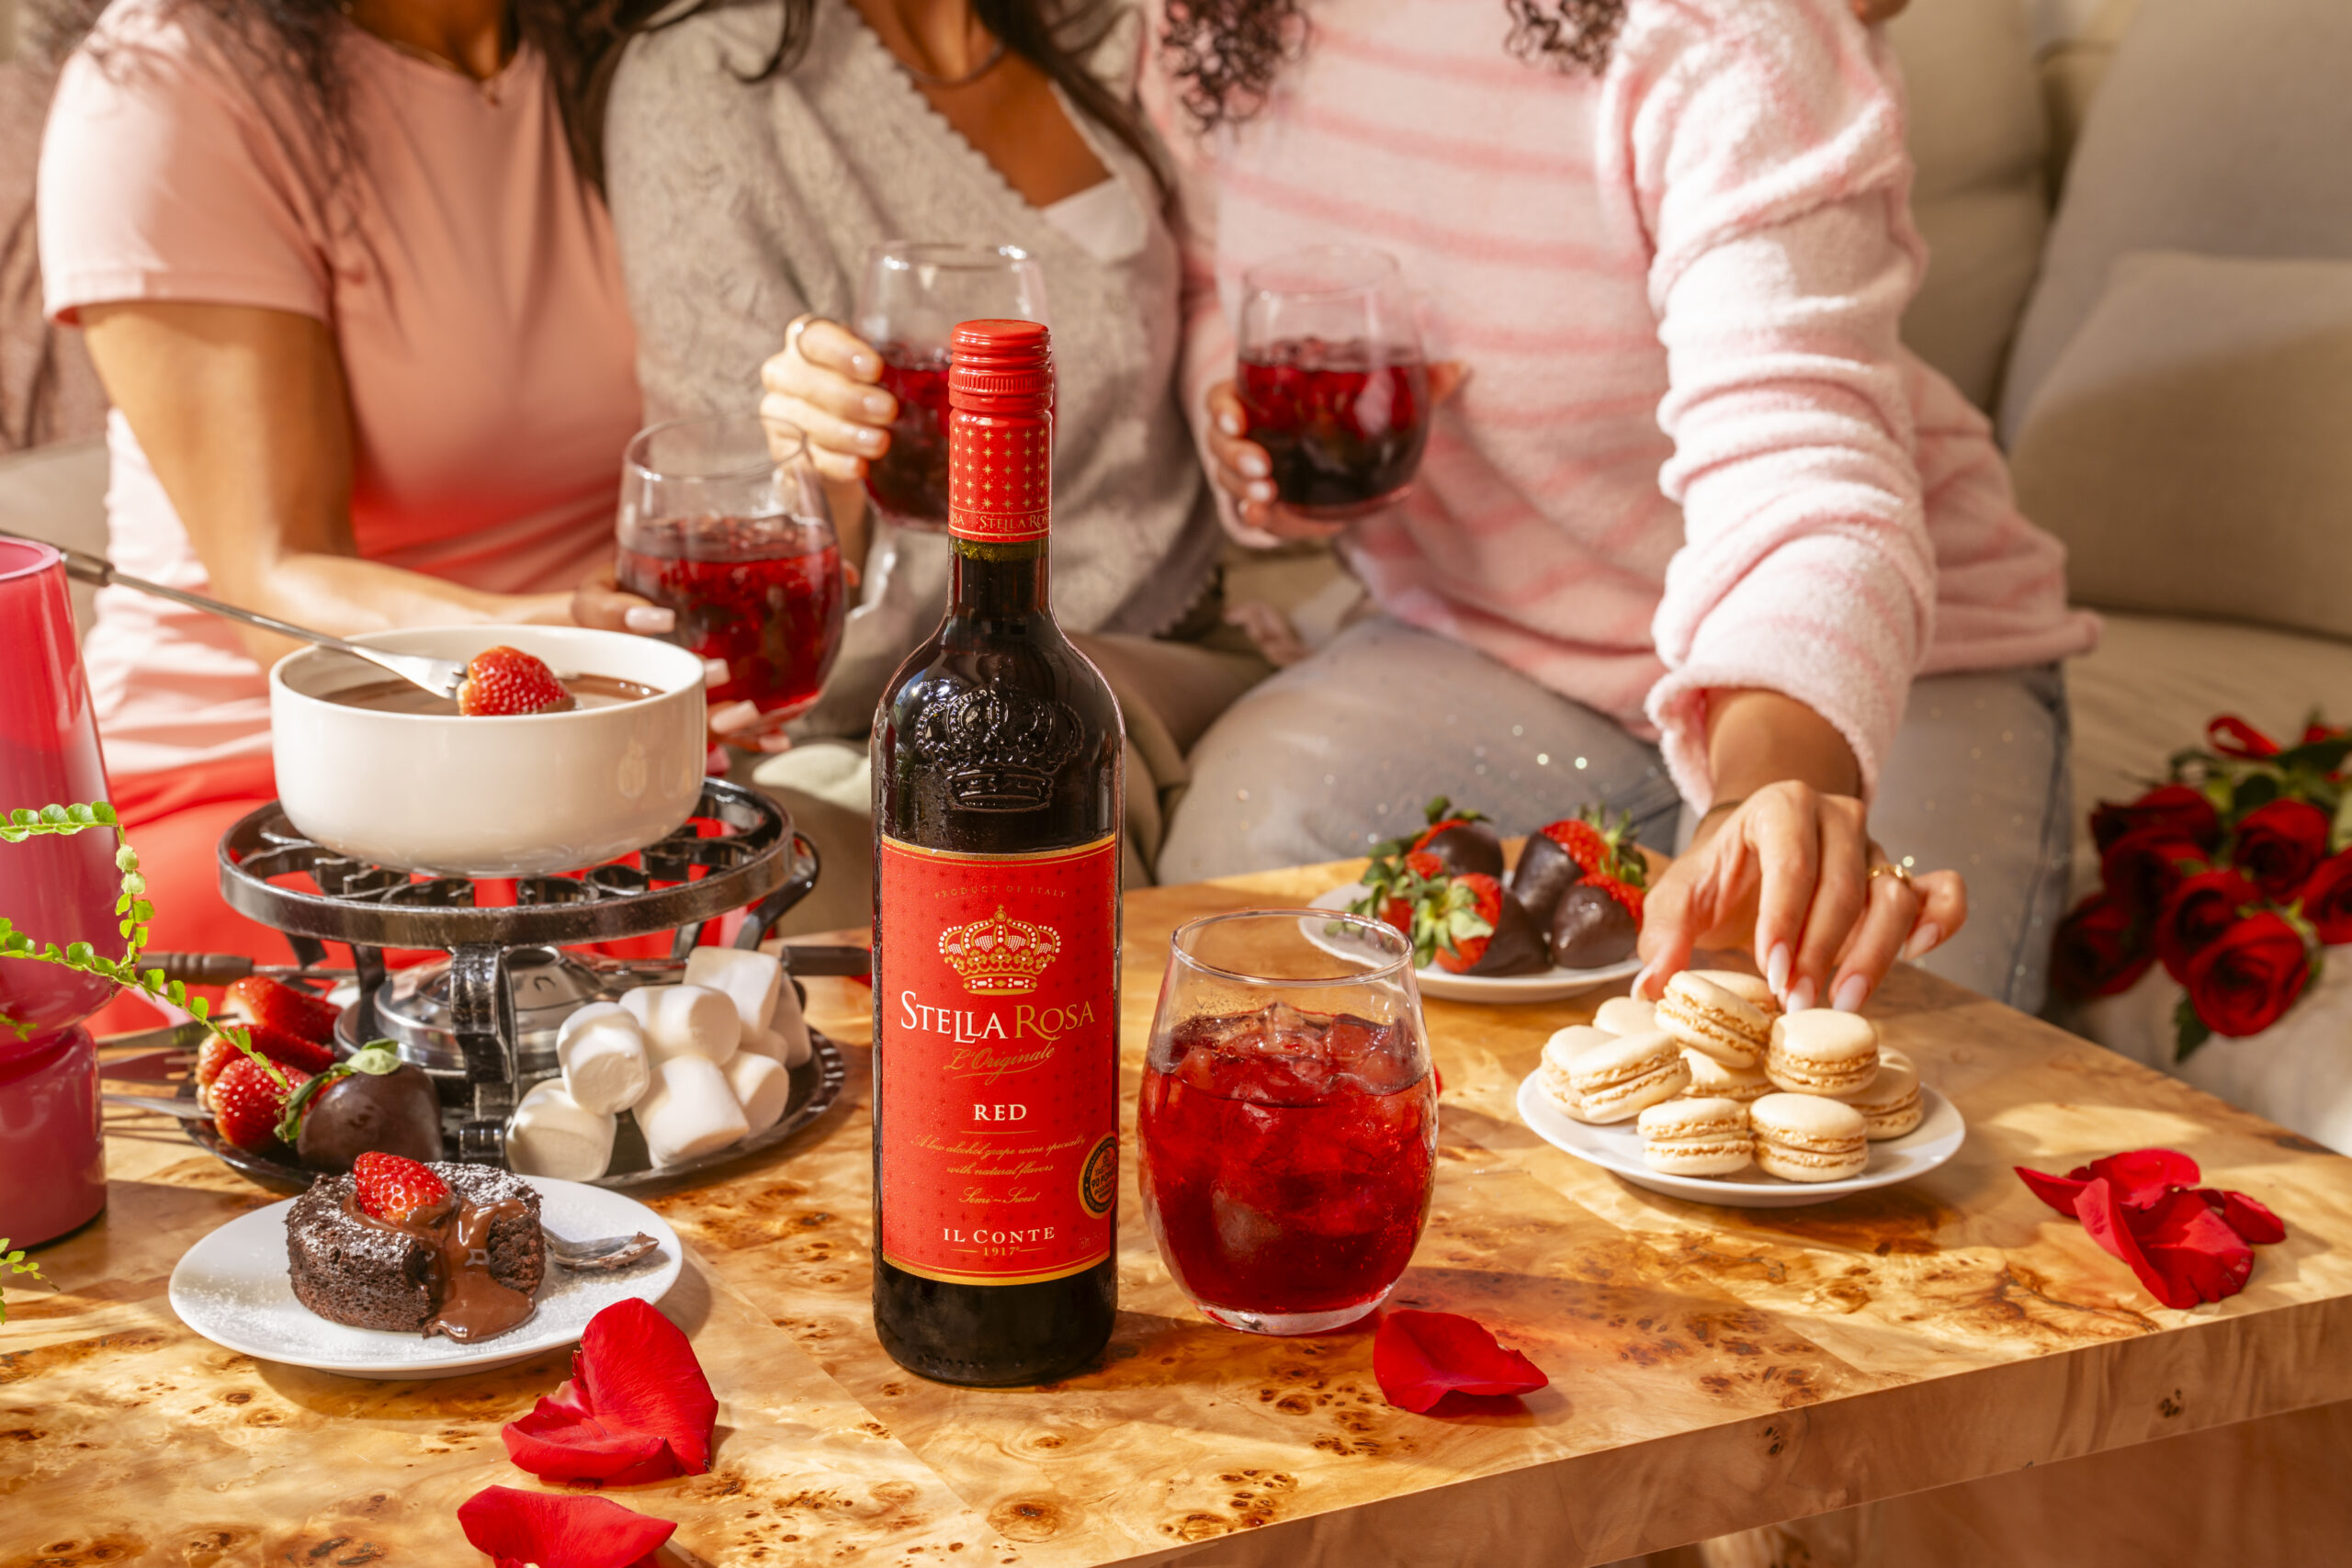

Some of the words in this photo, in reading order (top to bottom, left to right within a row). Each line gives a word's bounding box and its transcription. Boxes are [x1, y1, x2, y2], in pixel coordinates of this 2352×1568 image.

[979, 515, 1026, 532] STELLA
[934, 886, 997, 899] PRODUCT
[1006, 885, 1020, 893] OF
[1030, 886, 1066, 898] ITALY
[900, 990, 1009, 1044] STELLA
[1014, 1000, 1095, 1042] ROSA
[943, 1042, 1056, 1085] L'Originale
[973, 1103, 1028, 1122] RED
[926, 1137, 945, 1151] low
[945, 1141, 991, 1155] alcohol
[980, 1146, 1015, 1161] grape
[1018, 1145, 1045, 1155] wine
[1045, 1133, 1086, 1157] specialty
[946, 1161, 978, 1175] with
[974, 1161, 1026, 1176] natural
[1014, 1160, 1055, 1180] flavors
[943, 1227, 967, 1243] IL
[973, 1226, 1056, 1244] CONTE
